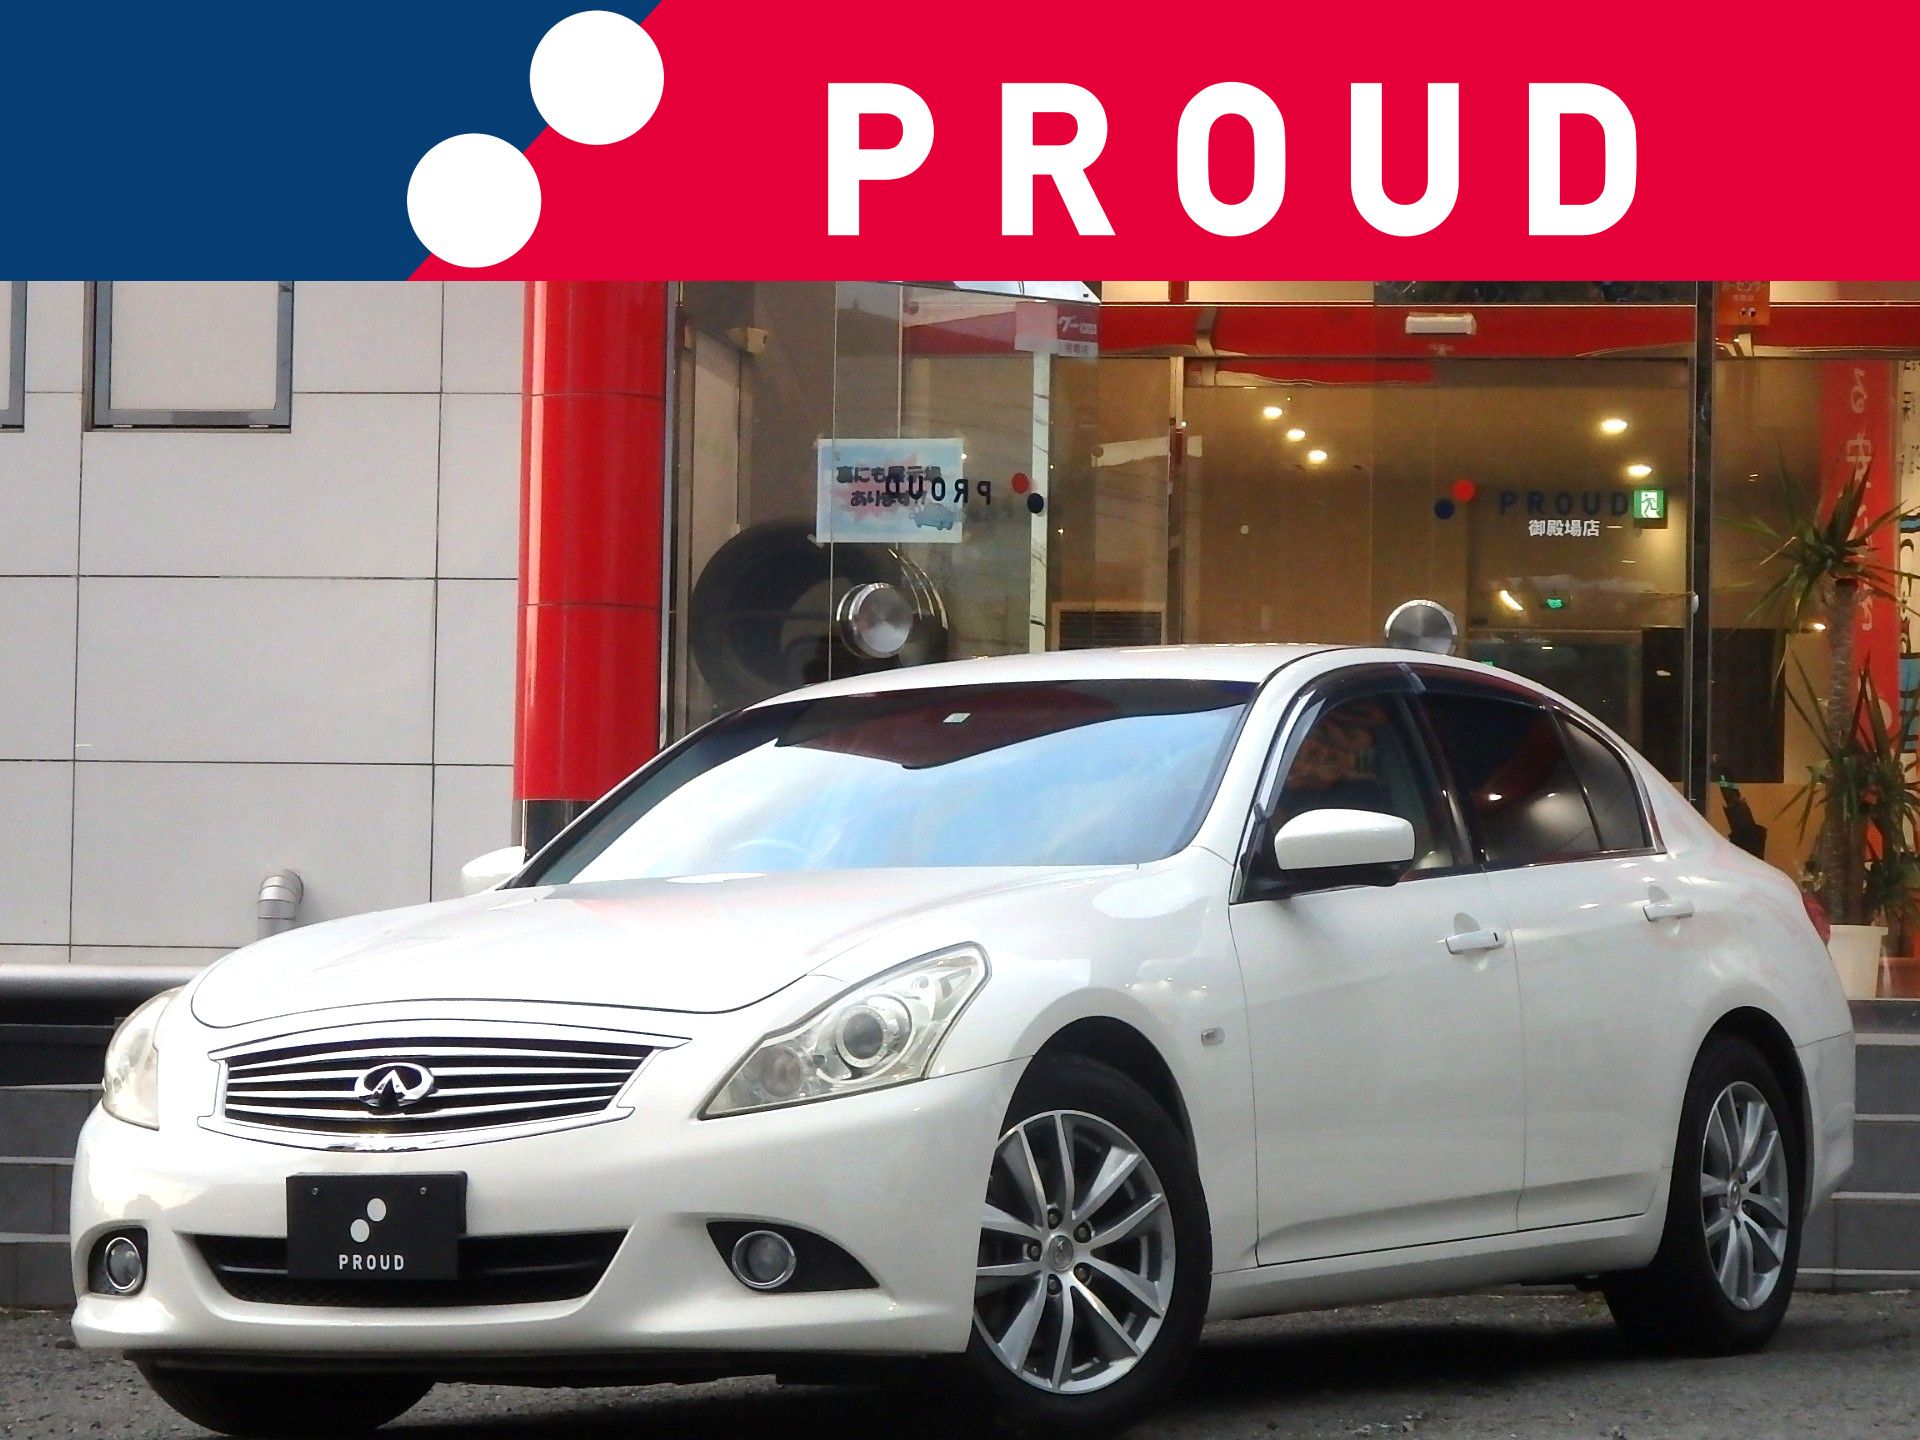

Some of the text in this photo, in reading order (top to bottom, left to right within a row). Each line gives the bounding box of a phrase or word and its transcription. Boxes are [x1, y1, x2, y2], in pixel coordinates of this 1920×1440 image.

[1499, 490, 1629, 517] PROUD
[1528, 519, 1601, 537] 御殿場店
[338, 1254, 405, 1271] PROUD
